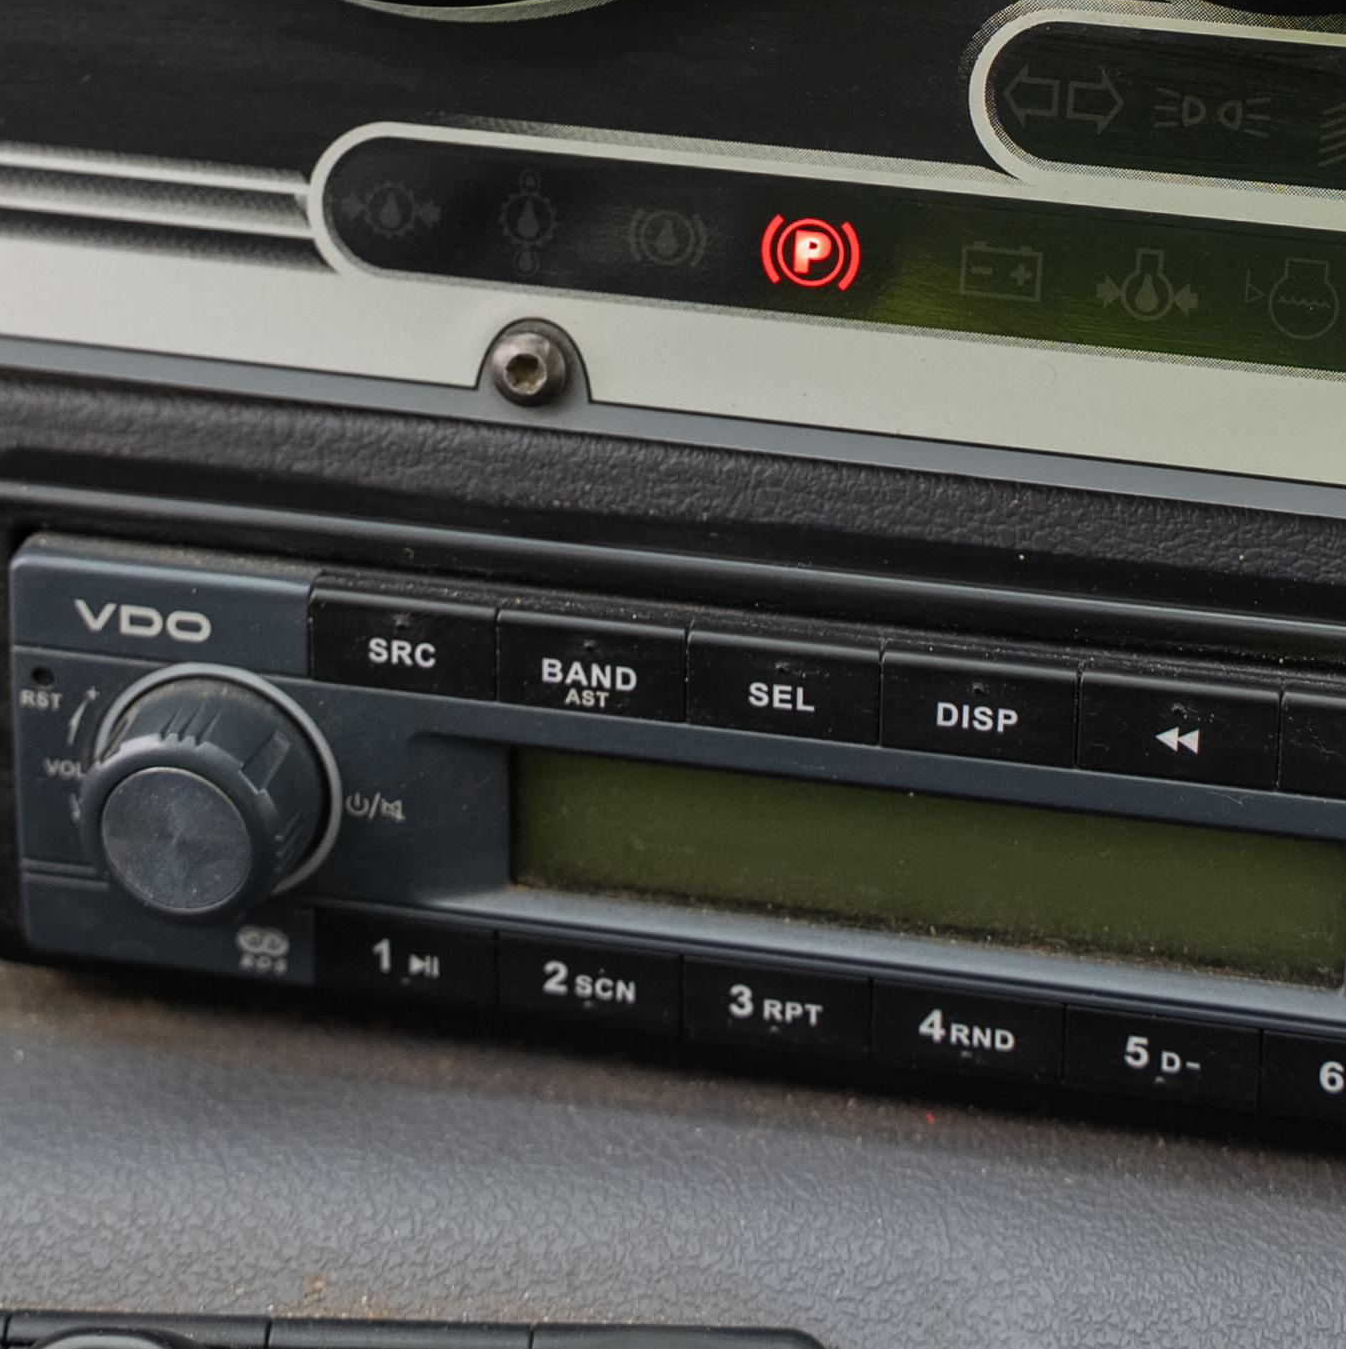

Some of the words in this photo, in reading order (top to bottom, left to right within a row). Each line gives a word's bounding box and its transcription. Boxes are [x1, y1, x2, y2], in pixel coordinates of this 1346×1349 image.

[793, 229, 833, 274] P
[74, 599, 212, 642] VDO
[368, 637, 437, 669] SRC
[541, 658, 637, 693] BAND
[20, 688, 63, 710] RST
[564, 688, 609, 708] AST
[748, 681, 816, 713] SEL
[936, 701, 1019, 734] DISP
[372, 939, 392, 973] 1
[543, 961, 568, 993] 2
[574, 974, 636, 1005] SCN
[729, 984, 754, 1018] 3
[762, 999, 824, 1027] RPT
[918, 1009, 946, 1043] 4
[949, 1023, 1015, 1052] RND
[1124, 1036, 1150, 1068] 5
[1318, 1061, 1345, 1095] 6
